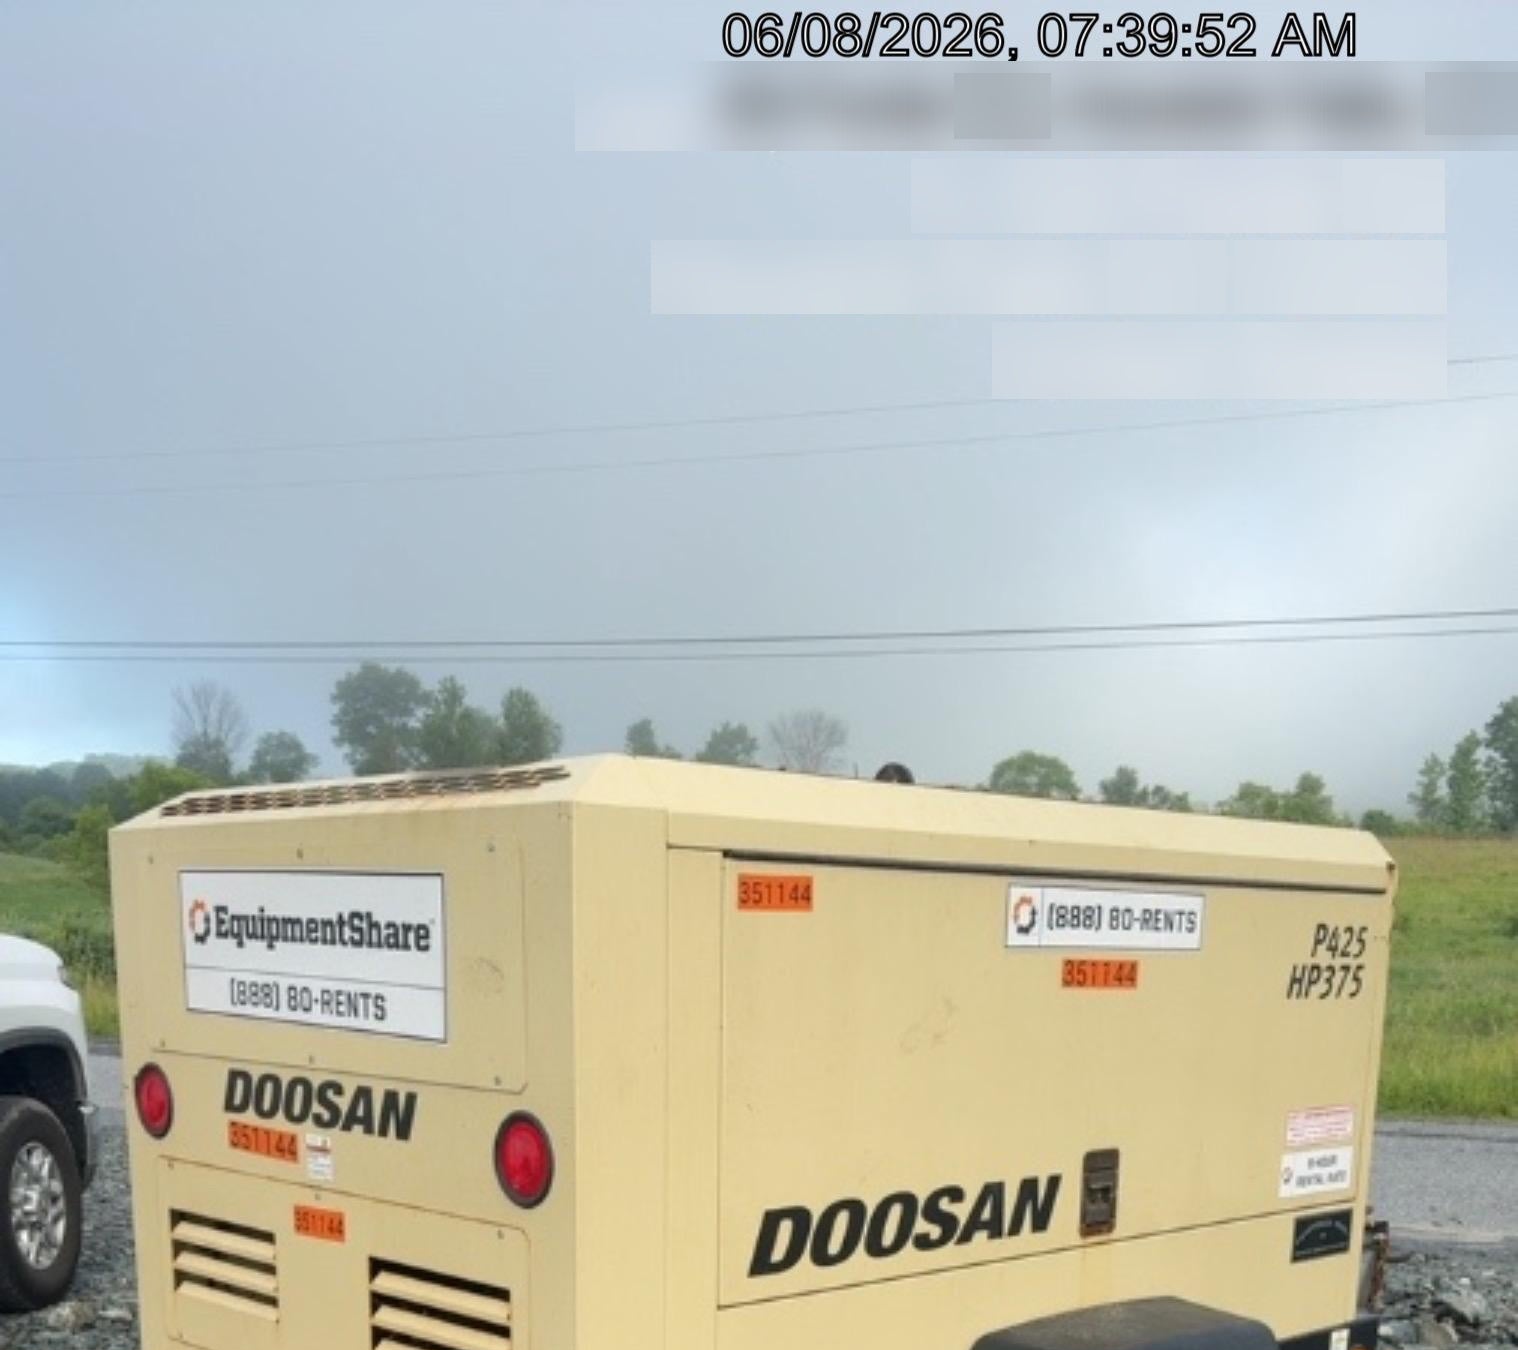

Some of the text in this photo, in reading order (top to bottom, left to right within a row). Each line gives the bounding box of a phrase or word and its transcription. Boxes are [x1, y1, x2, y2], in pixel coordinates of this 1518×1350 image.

[738, 880, 812, 905] 351144
[213, 904, 431, 952] EquipmentShare
[1048, 902, 1198, 934] (888) 80-RENTS
[1310, 923, 1368, 960] P425
[1062, 960, 1138, 987] 351144
[1286, 964, 1365, 1000] HP375
[229, 977, 387, 1022] (888) 80-RENTS
[224, 1068, 417, 1141] DOOSAN
[229, 1121, 298, 1162] 351144
[295, 1207, 344, 1238] 351144
[746, 1173, 1063, 1278] DOOSAN
